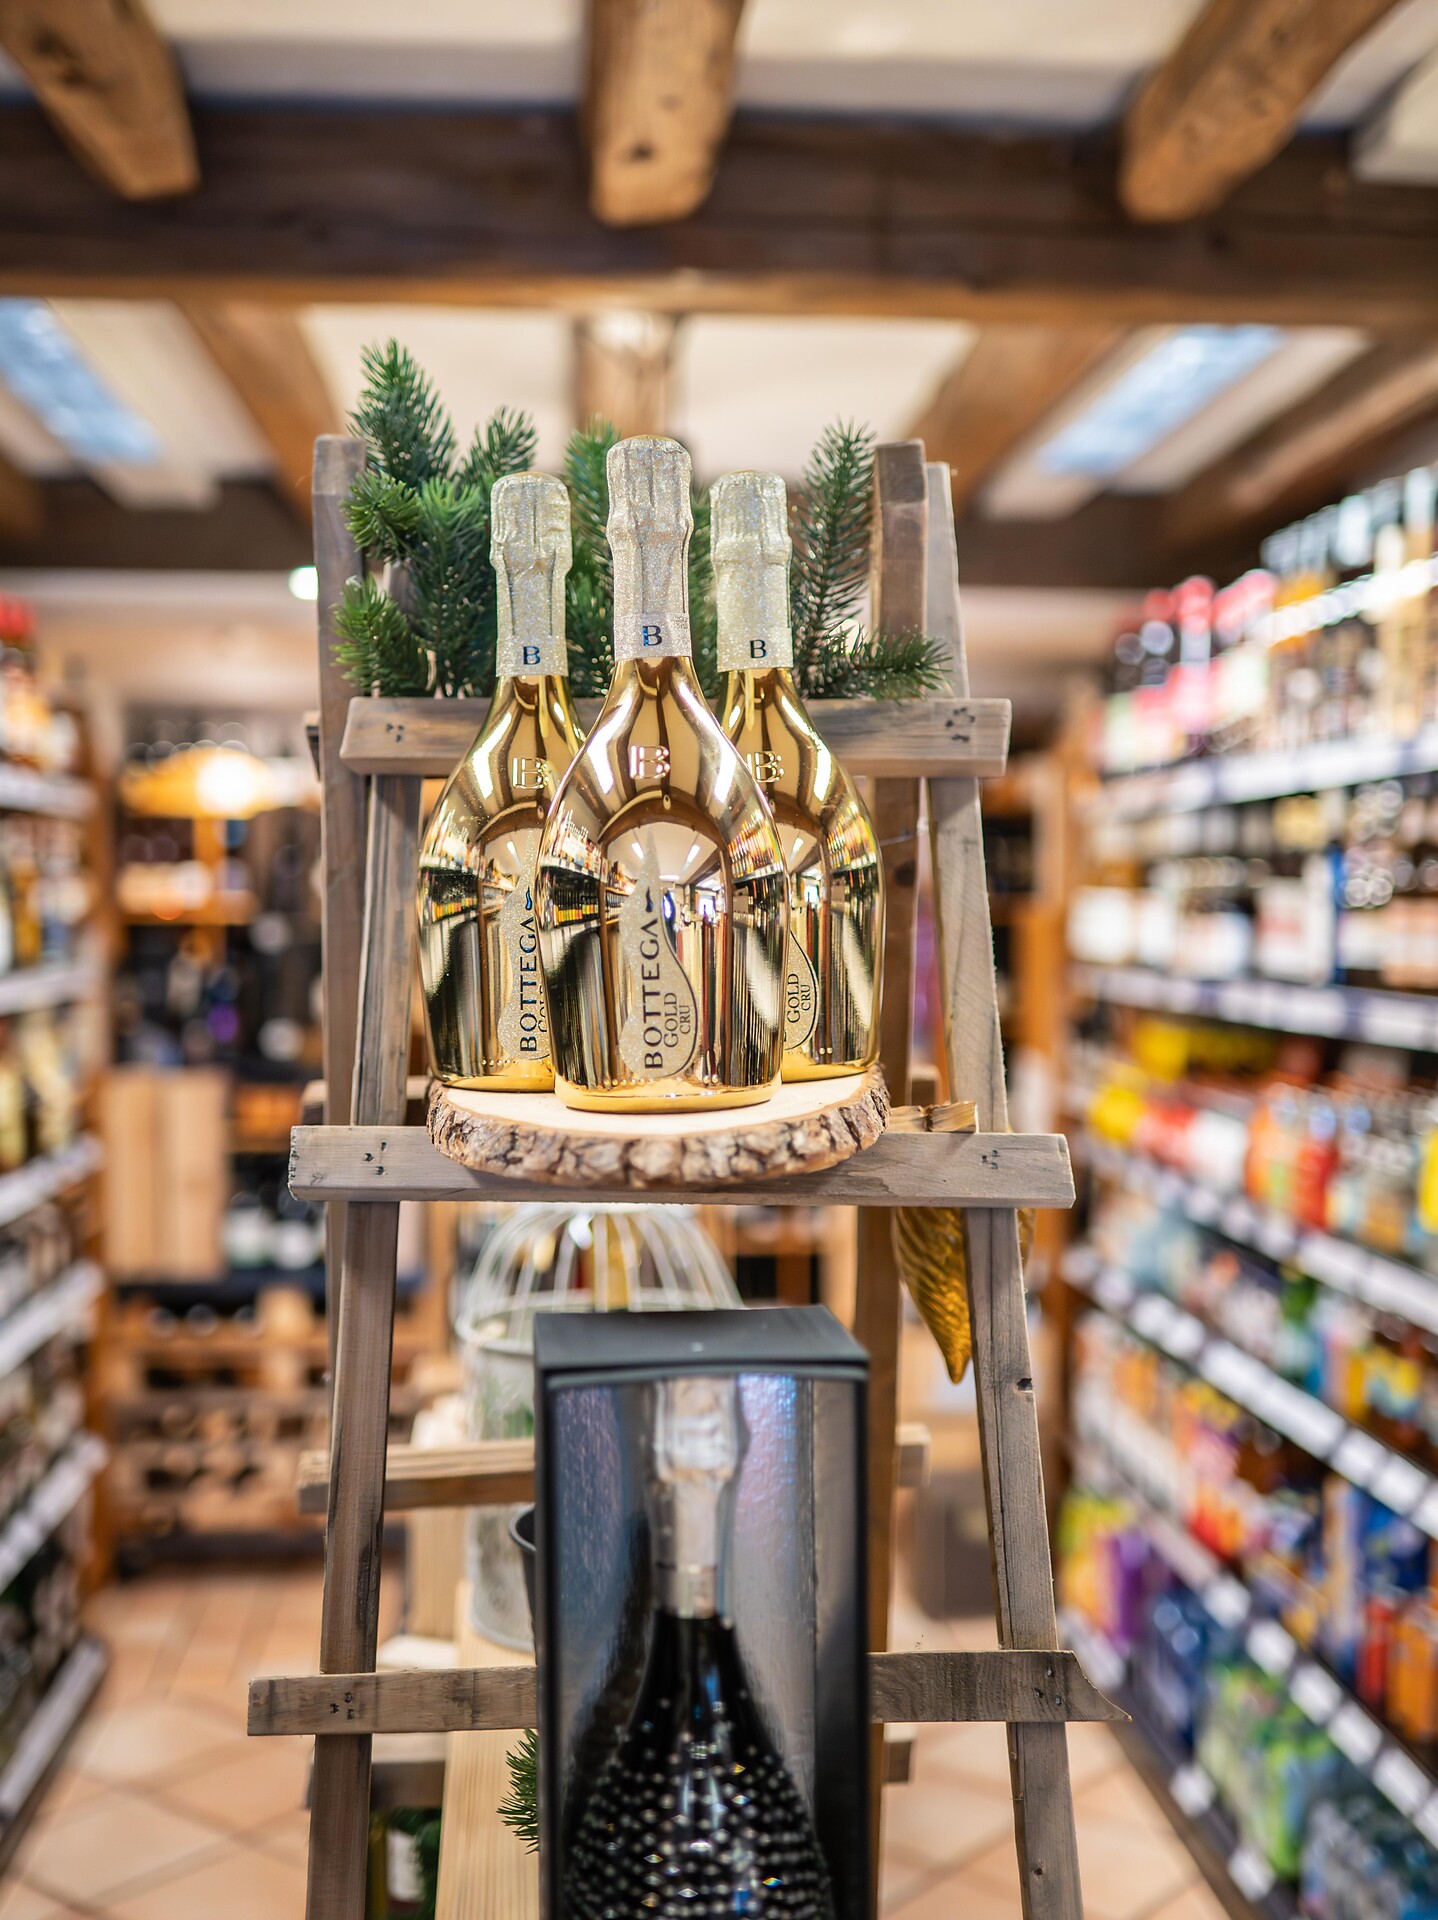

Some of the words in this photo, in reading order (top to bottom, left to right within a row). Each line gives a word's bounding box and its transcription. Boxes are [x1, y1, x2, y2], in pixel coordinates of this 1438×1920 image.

[642, 625, 663, 647] B
[750, 639, 768, 659] B
[522, 645, 542, 666] B
[519, 916, 537, 1051] BOTTEGA
[639, 918, 663, 1069] BOTTEGA
[786, 973, 801, 1023] GOLD
[801, 984, 811, 1011] CRU
[663, 992, 679, 1048] GOLD
[679, 1004, 691, 1035] CRU
